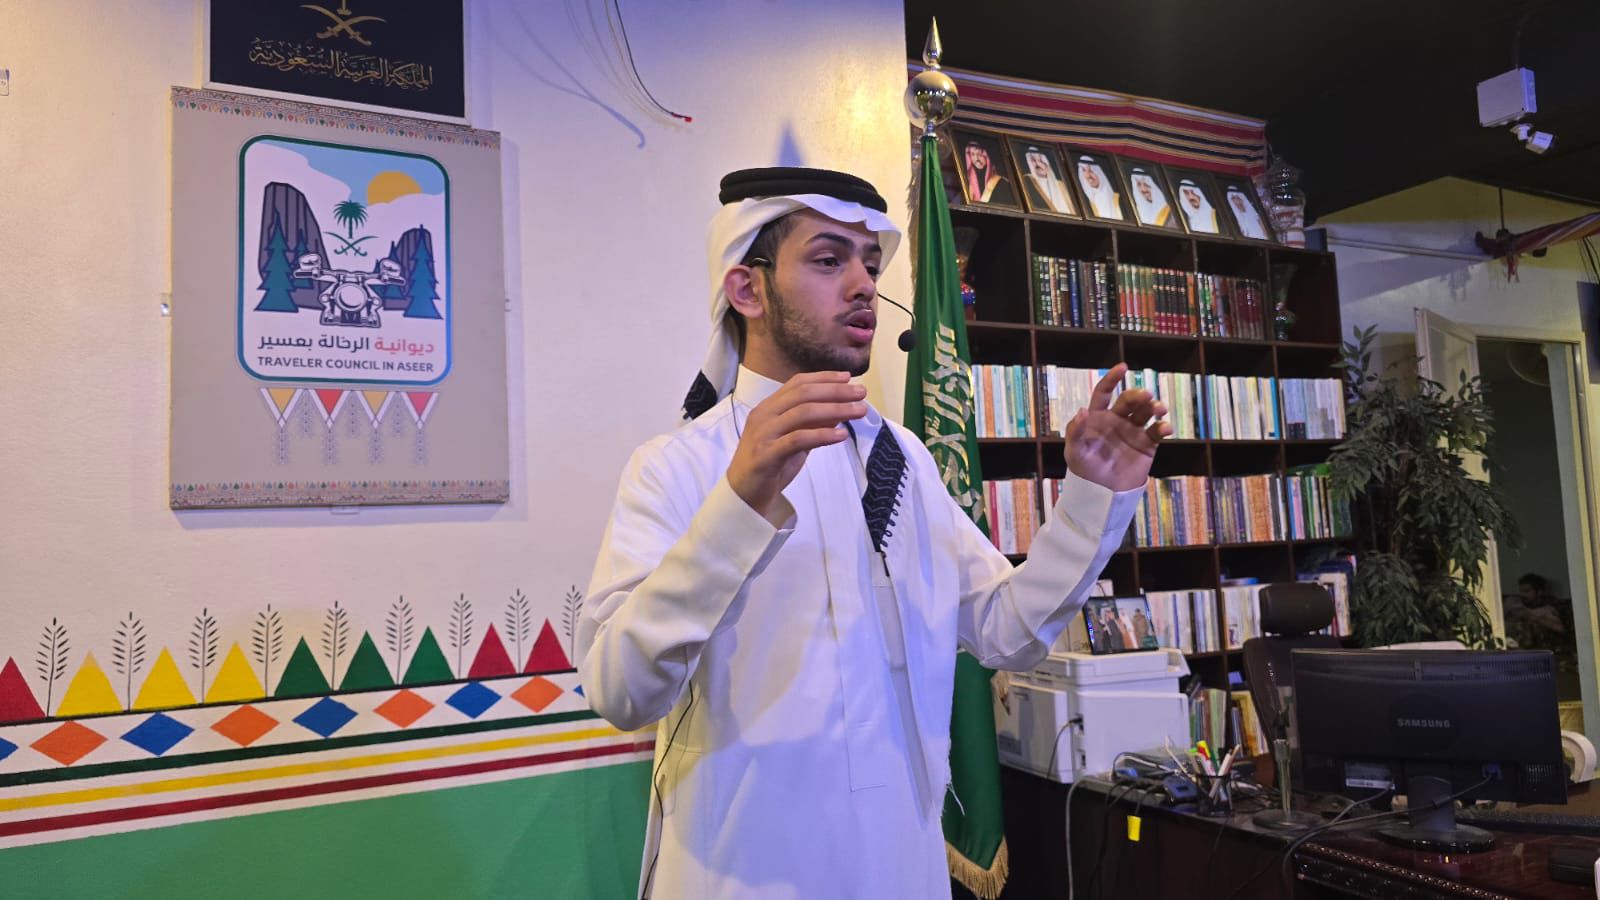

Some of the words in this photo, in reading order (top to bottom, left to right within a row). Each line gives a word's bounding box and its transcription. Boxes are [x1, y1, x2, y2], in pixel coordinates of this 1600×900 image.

[257, 335, 313, 351] بعسير
[374, 338, 434, 356] ديوانية
[257, 356, 323, 369] TRAVELER
[325, 359, 380, 371] COUNCIL
[382, 361, 394, 372] IN
[397, 362, 434, 373] ASEER
[1396, 718, 1451, 729] SAMSUNG
